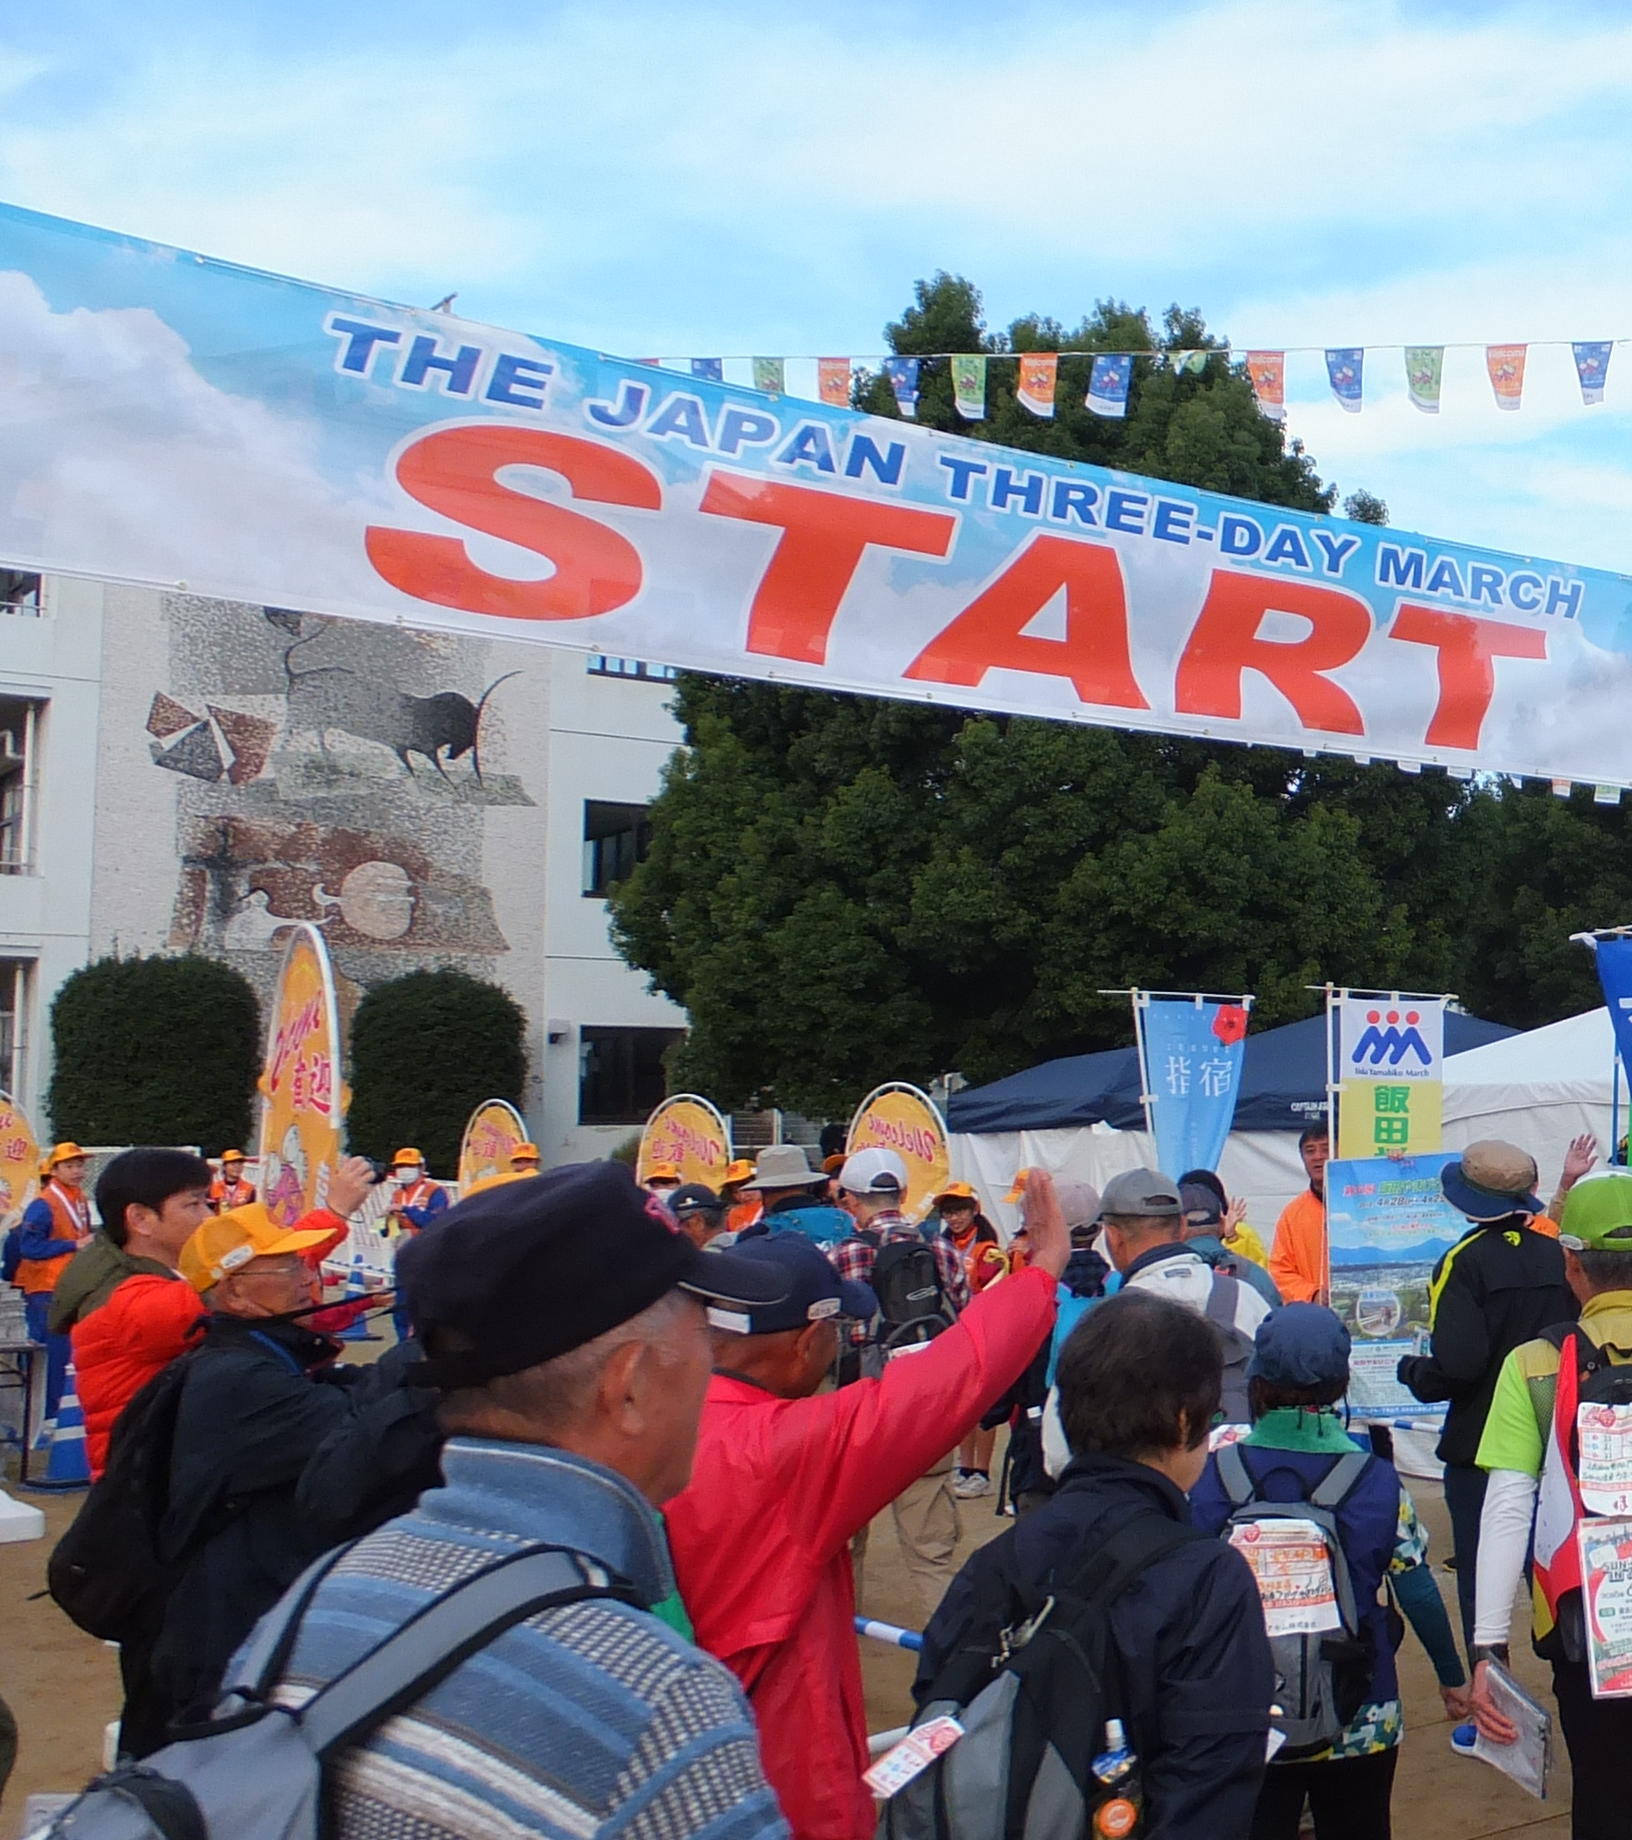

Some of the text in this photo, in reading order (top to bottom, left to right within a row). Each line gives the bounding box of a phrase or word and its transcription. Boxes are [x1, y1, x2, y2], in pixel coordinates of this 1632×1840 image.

[331, 317, 1583, 619] THE JAPAN THREE-DAY MARCH
[364, 425, 1548, 750] START
[1164, 1055, 1233, 1098] 指宿
[1405, 1068, 1430, 1077] March
[1374, 1085, 1411, 1155] 飯田
